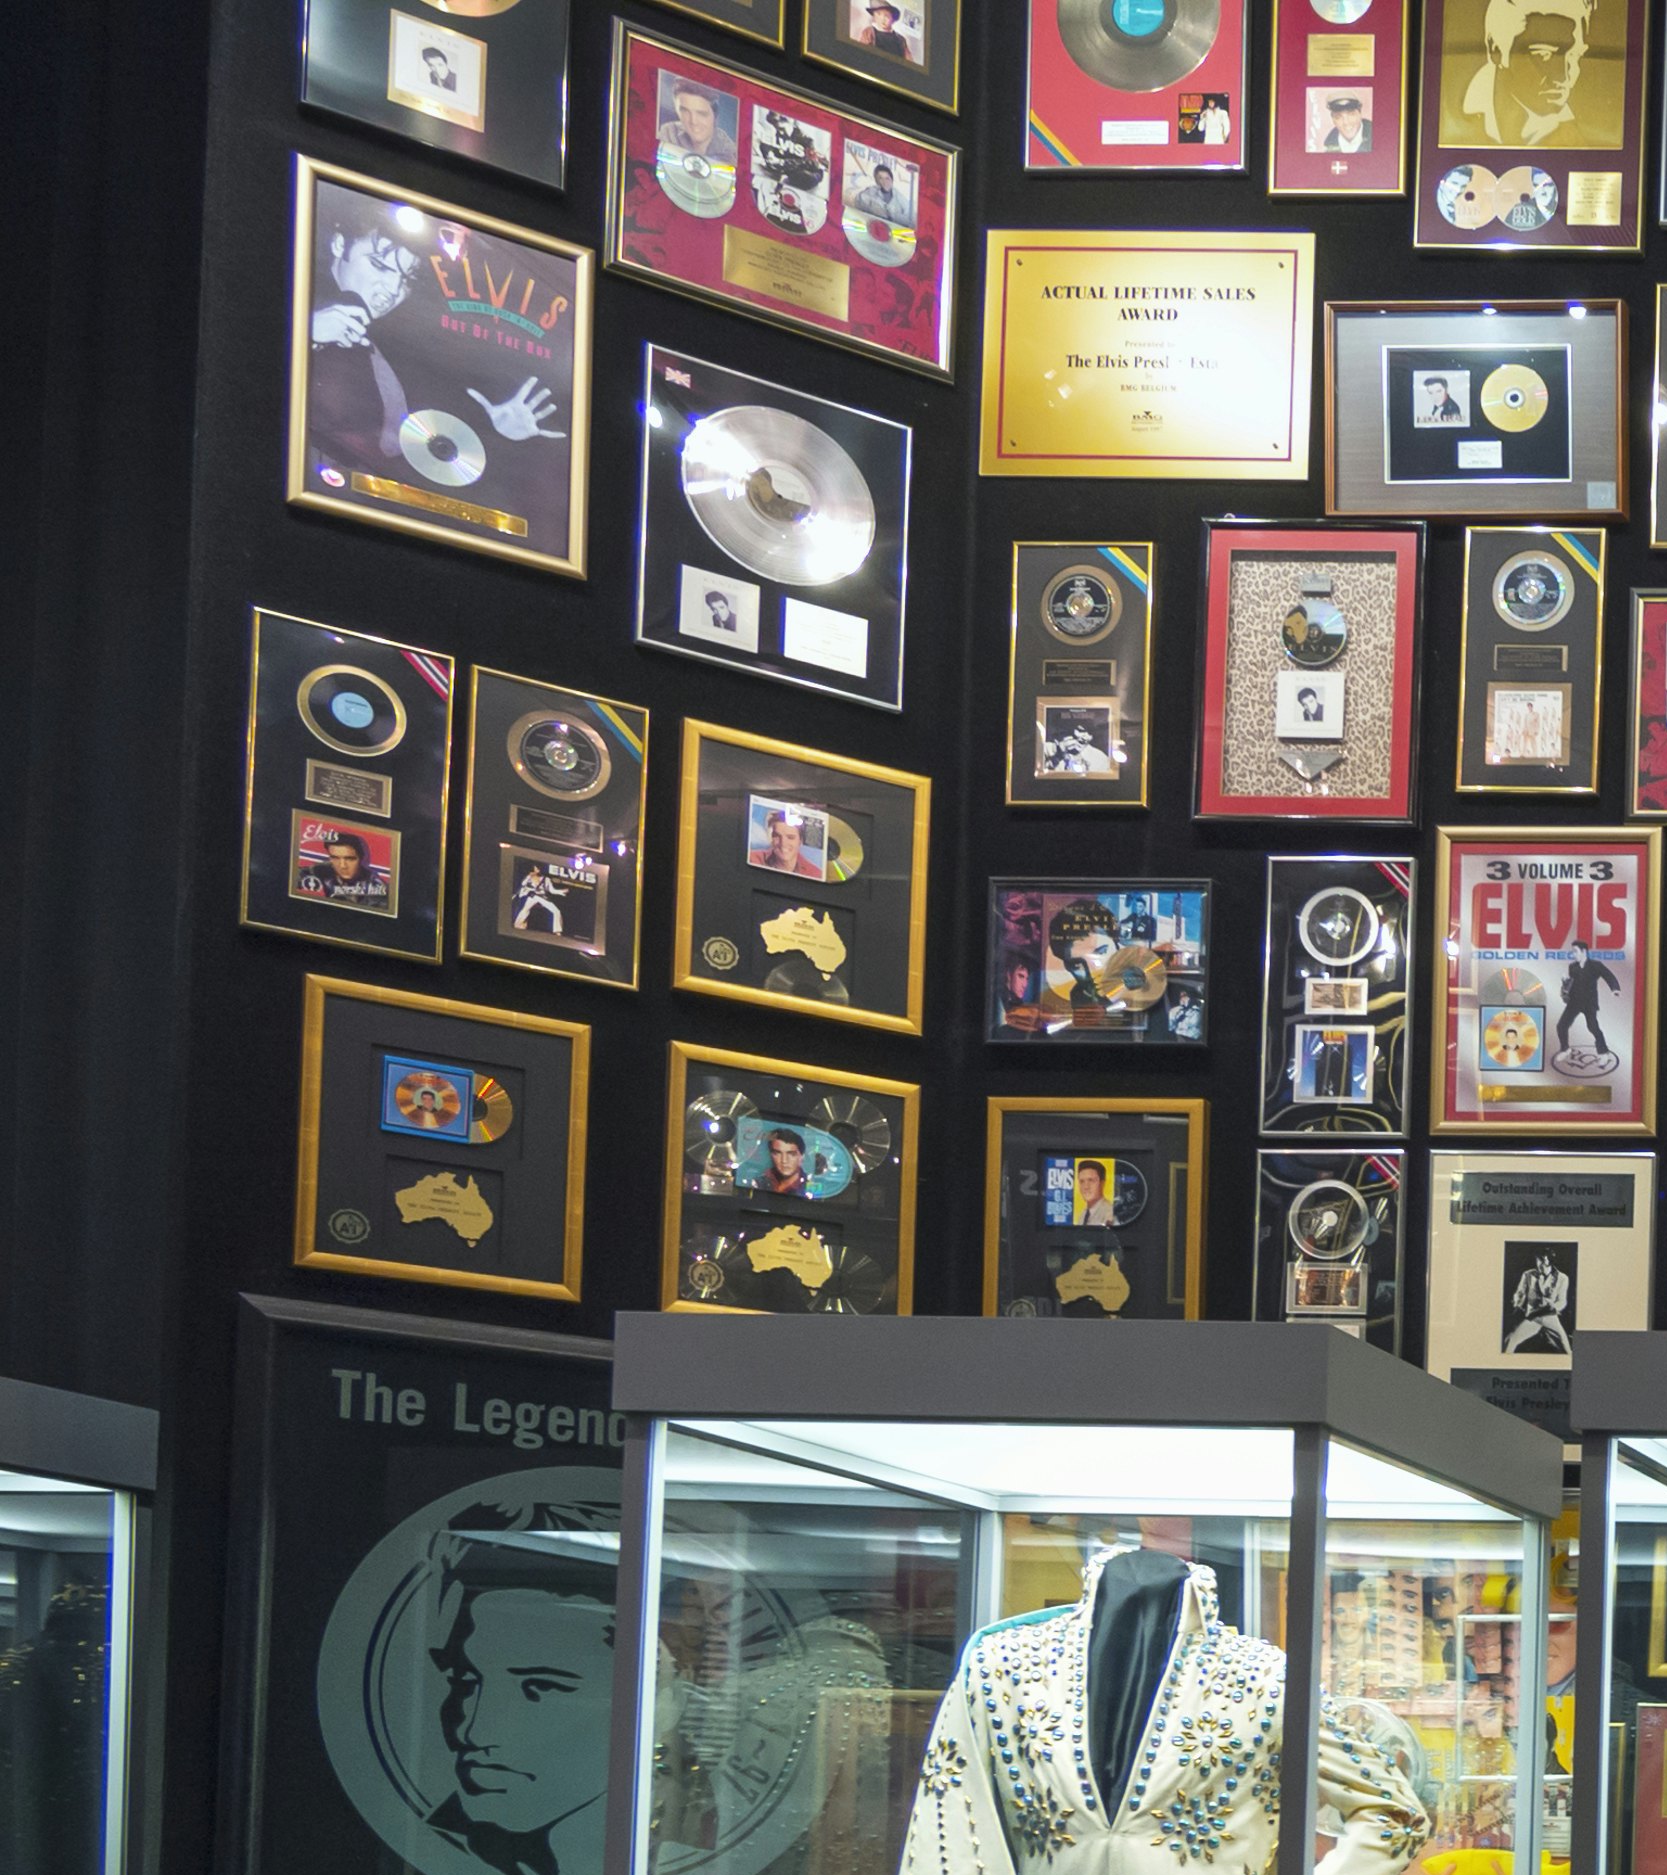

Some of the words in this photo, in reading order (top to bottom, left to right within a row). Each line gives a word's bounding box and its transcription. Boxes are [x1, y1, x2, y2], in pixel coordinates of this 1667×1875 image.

[430, 248, 568, 330] ELVIS
[1041, 286, 1107, 300] ACTUAL
[1114, 287, 1197, 300] LIFETIME
[1203, 288, 1256, 301] SALES
[1117, 308, 1178, 321] AWARD
[1066, 355, 1092, 368] The
[1096, 354, 1129, 368] Elvis
[301, 824, 339, 844] Elvis
[549, 864, 597, 884] ELVIS
[1486, 861, 1510, 880] 3
[1517, 862, 1583, 880] VOLUME
[1589, 861, 1614, 880] 3
[1471, 882, 1628, 950] ELVIS
[1559, 950, 1626, 961] RECRDS
[1048, 1168, 1074, 1190] ELVIS
[1482, 1182, 1553, 1198] Outstanding
[1559, 1183, 1602, 1196] Overall
[1457, 1201, 1503, 1214] Lifetime
[1509, 1203, 1584, 1216] Achievement
[1589, 1204, 1627, 1216] Award
[1492, 1377, 1559, 1389] Presented
[332, 1368, 426, 1427] The
